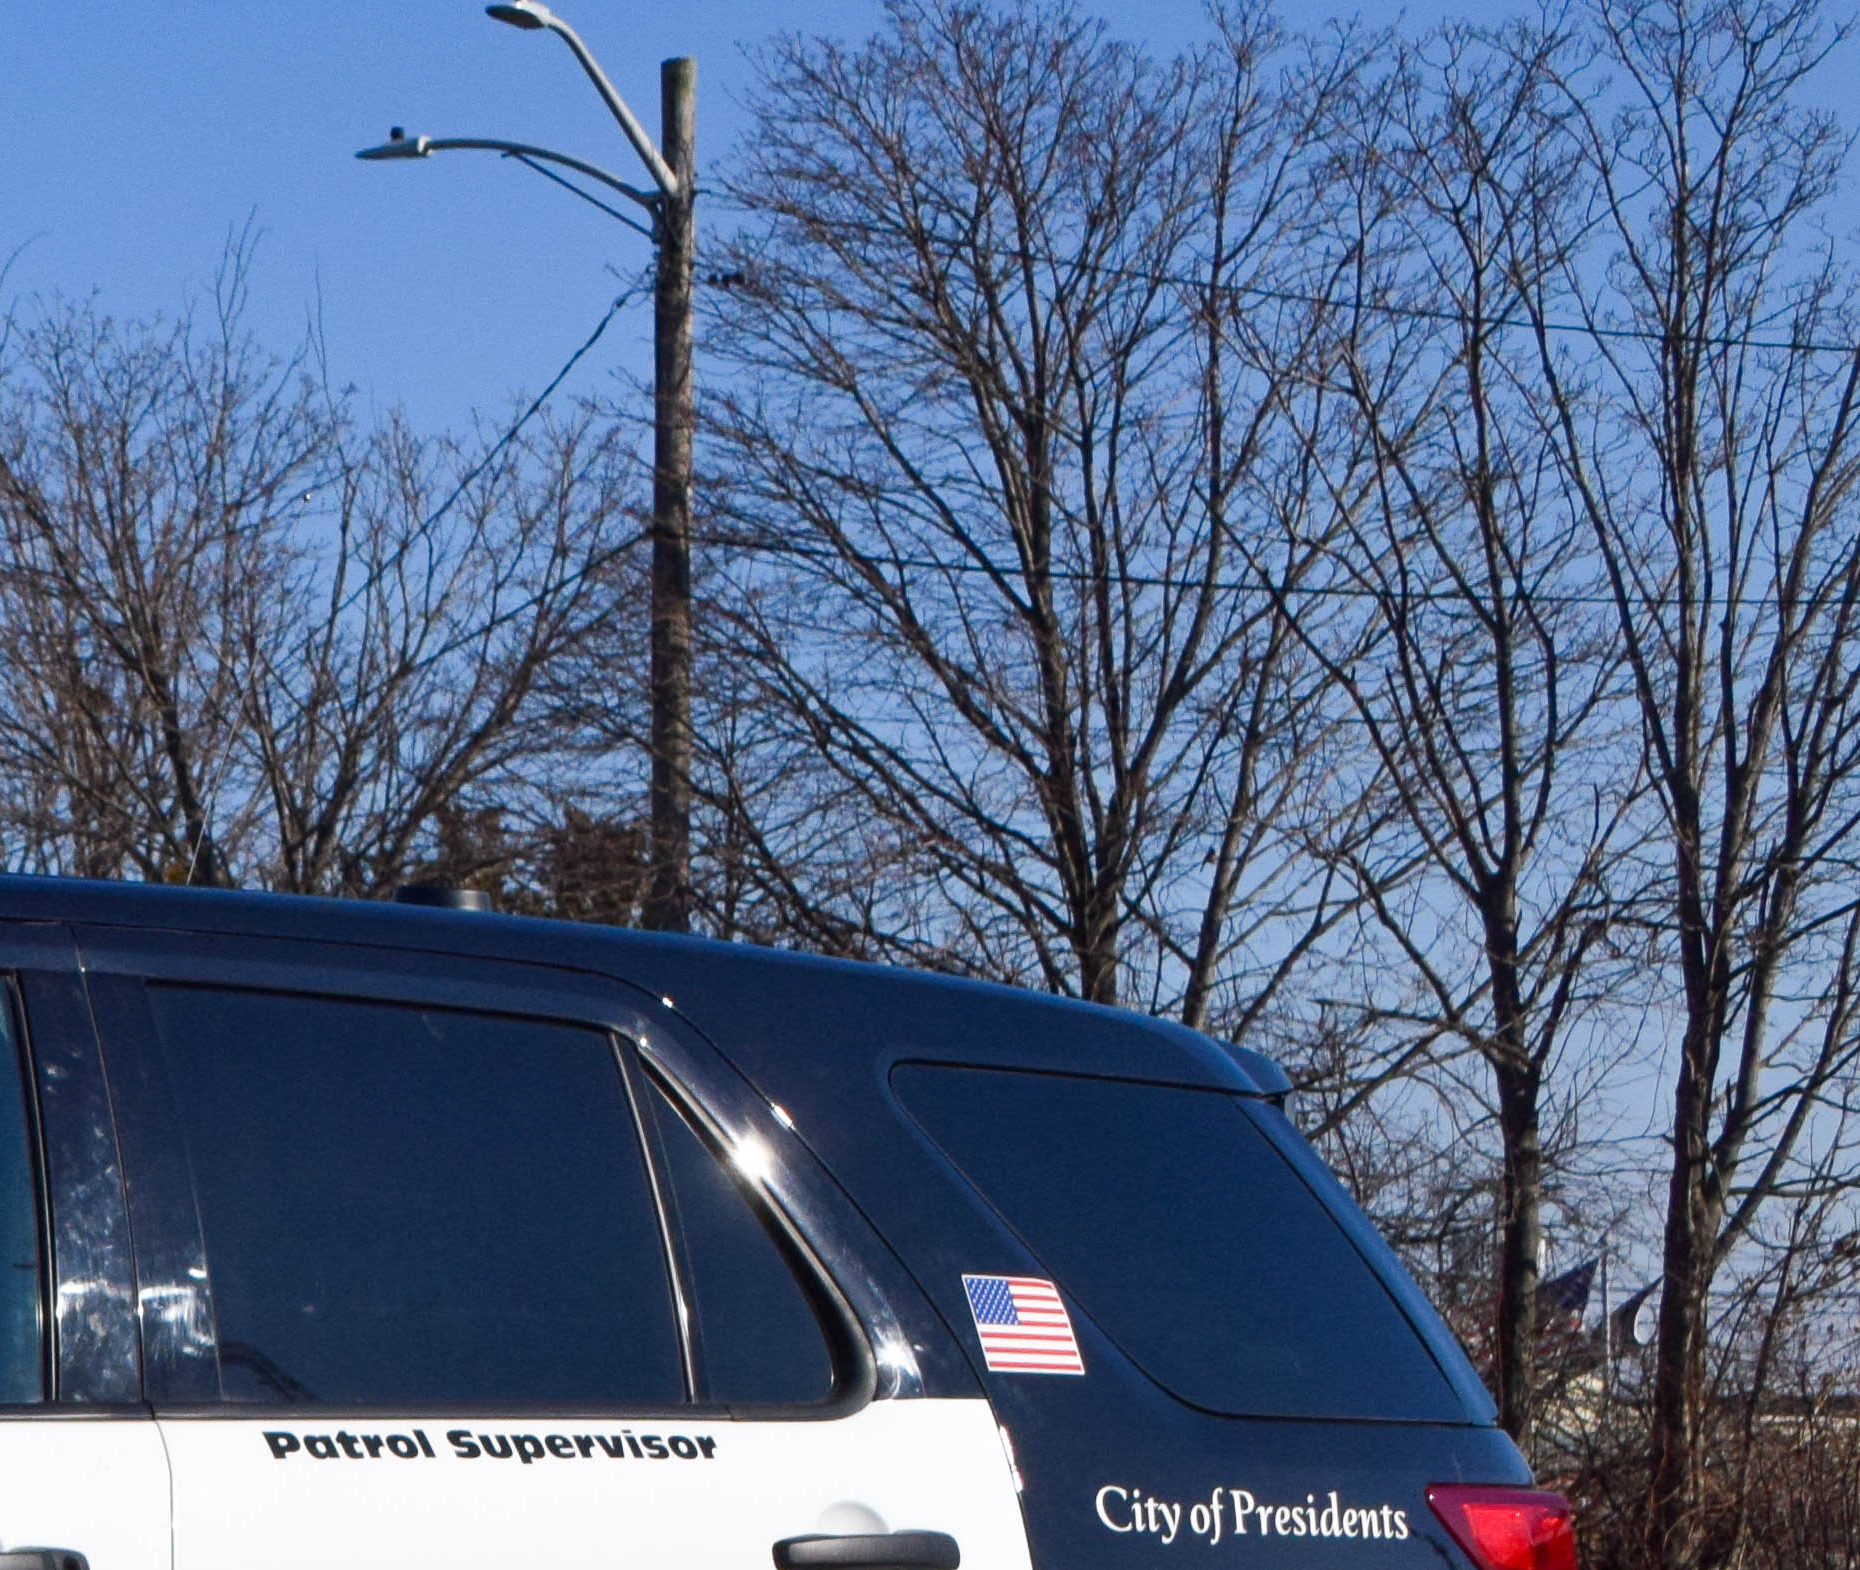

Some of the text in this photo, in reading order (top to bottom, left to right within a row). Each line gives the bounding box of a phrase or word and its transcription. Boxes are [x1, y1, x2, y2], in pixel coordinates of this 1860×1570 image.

[262, 1429, 719, 1465] Patrol Supervisor
[1094, 1485, 1410, 1546] City of Presidents
